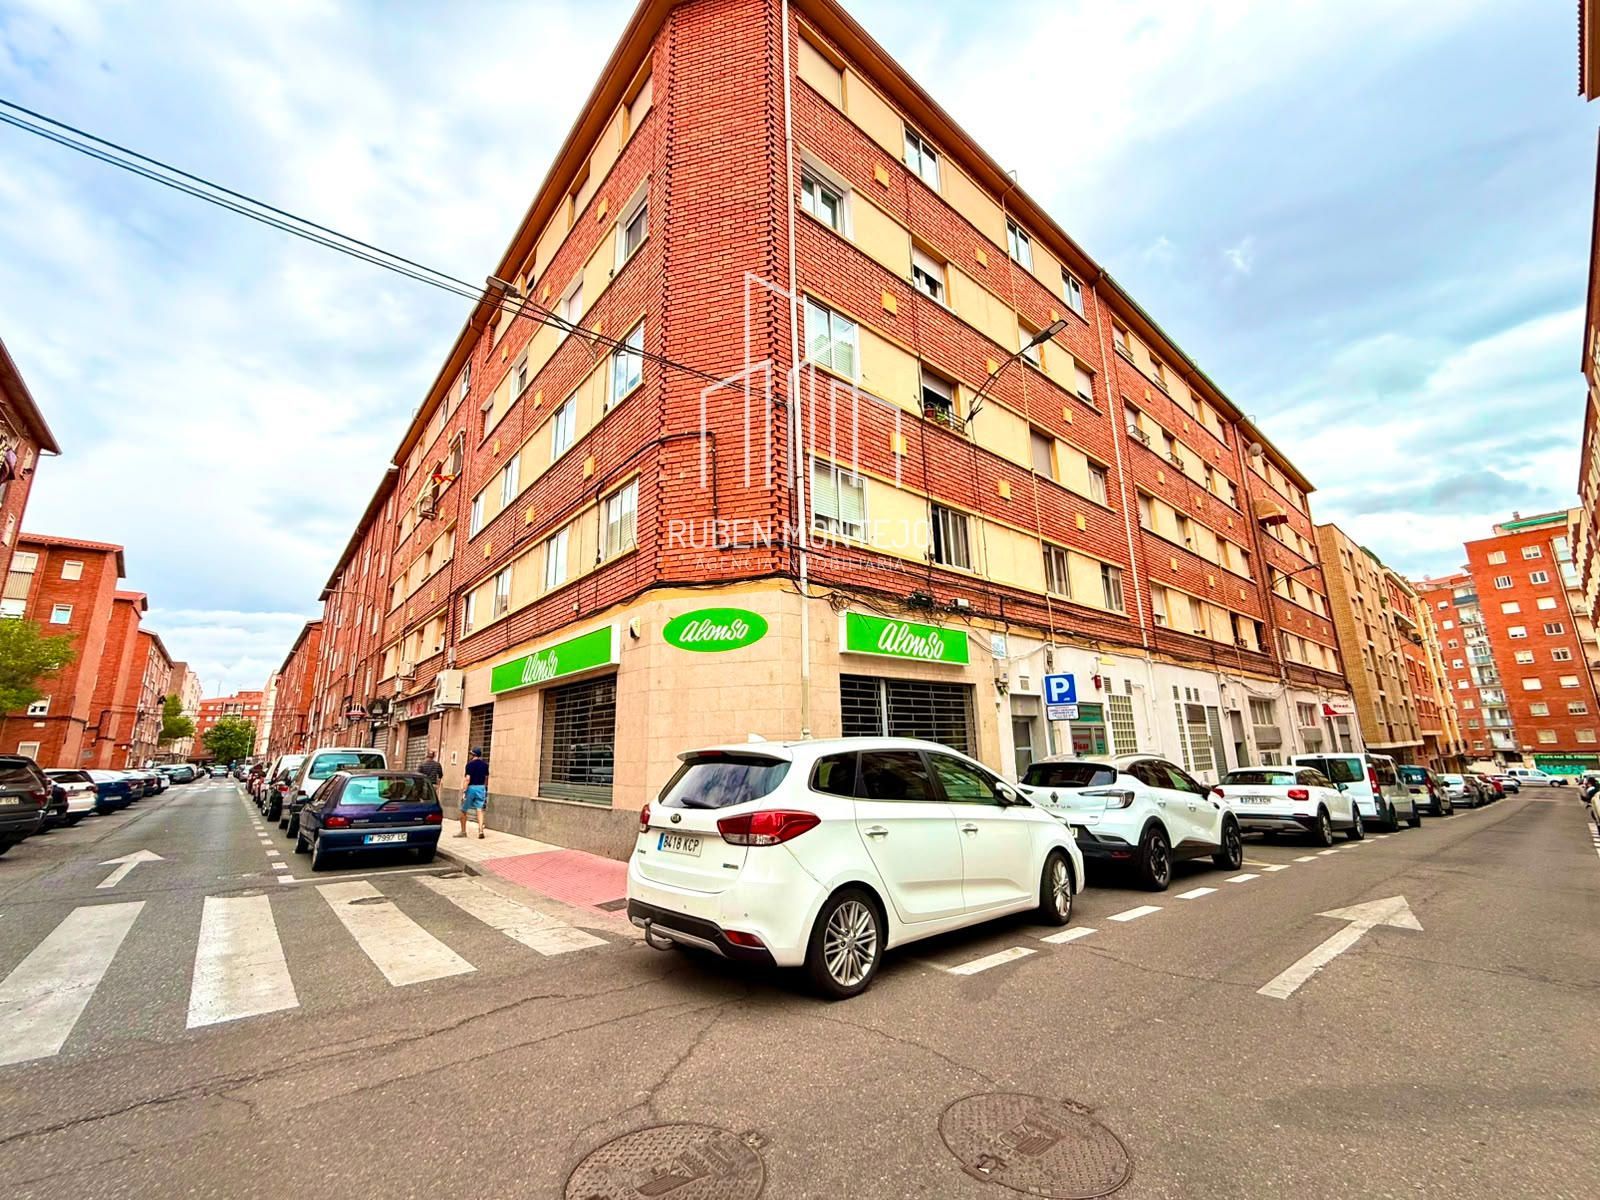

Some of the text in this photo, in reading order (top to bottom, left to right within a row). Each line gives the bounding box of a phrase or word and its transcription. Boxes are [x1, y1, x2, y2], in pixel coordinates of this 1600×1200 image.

[1049, 677, 1070, 702] P
[663, 835, 700, 853] 8418 KCP
